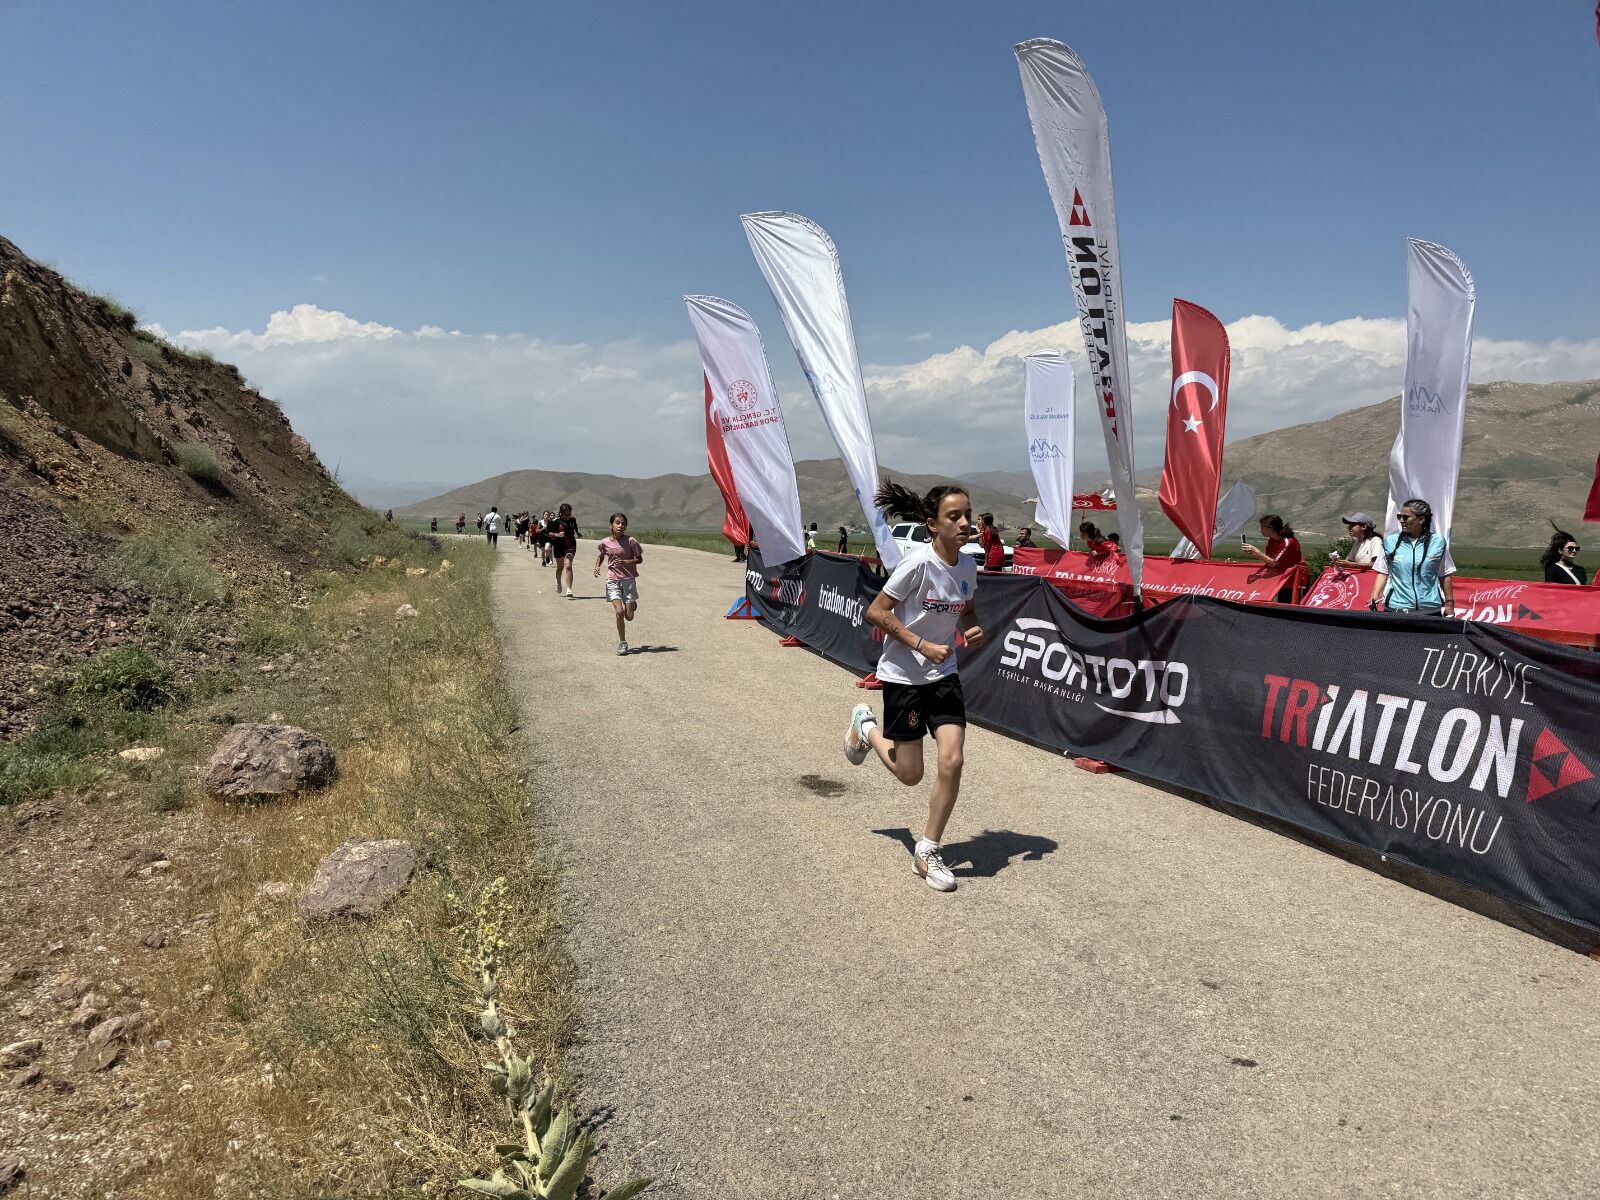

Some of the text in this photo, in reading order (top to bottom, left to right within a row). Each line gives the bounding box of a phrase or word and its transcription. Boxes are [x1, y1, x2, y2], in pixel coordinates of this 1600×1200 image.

[998, 668, 1085, 704] TEŞKİLAT BAŞKANLIĞI
[1000, 630, 1189, 707] SPORTOTO
[1418, 643, 1541, 706] TÜRKİYE
[1307, 764, 1503, 855] FEDERASYONU
